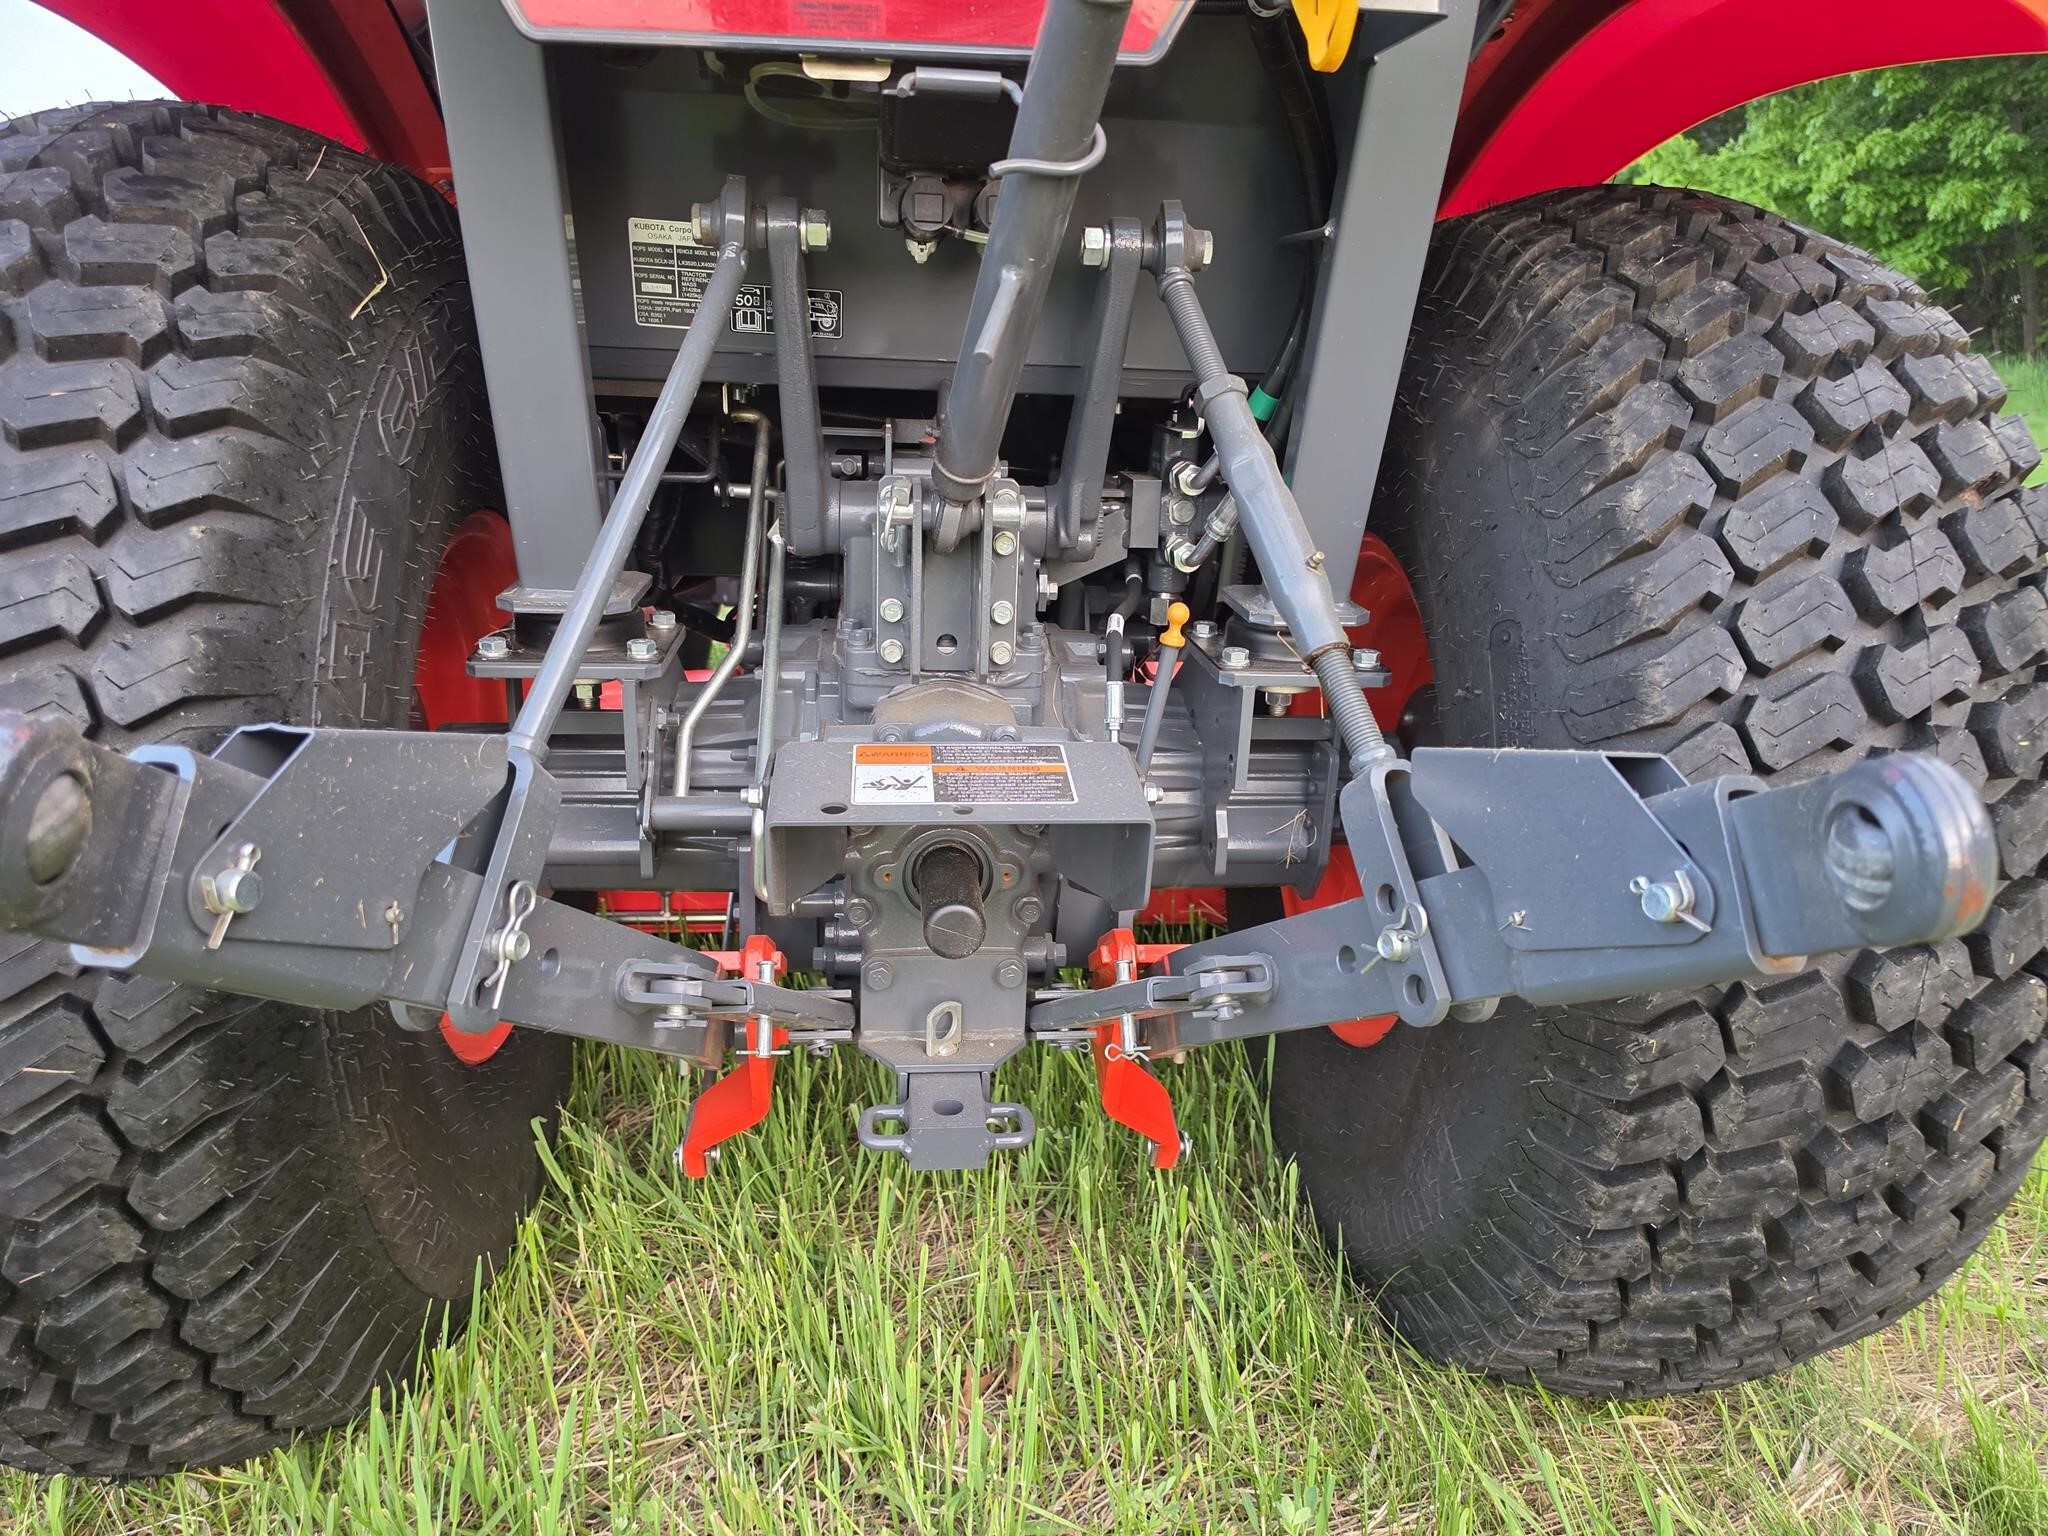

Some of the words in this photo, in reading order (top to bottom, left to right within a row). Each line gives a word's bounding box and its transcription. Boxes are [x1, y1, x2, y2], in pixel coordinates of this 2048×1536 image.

[634, 222, 665, 232] KUBOTA
[668, 225, 692, 234] Corpo
[647, 232, 673, 241] OSAKA
[647, 246, 664, 254] MODEL
[694, 249, 709, 257] MODEL
[633, 256, 654, 264] KUBOTA
[736, 294, 753, 307] 50
